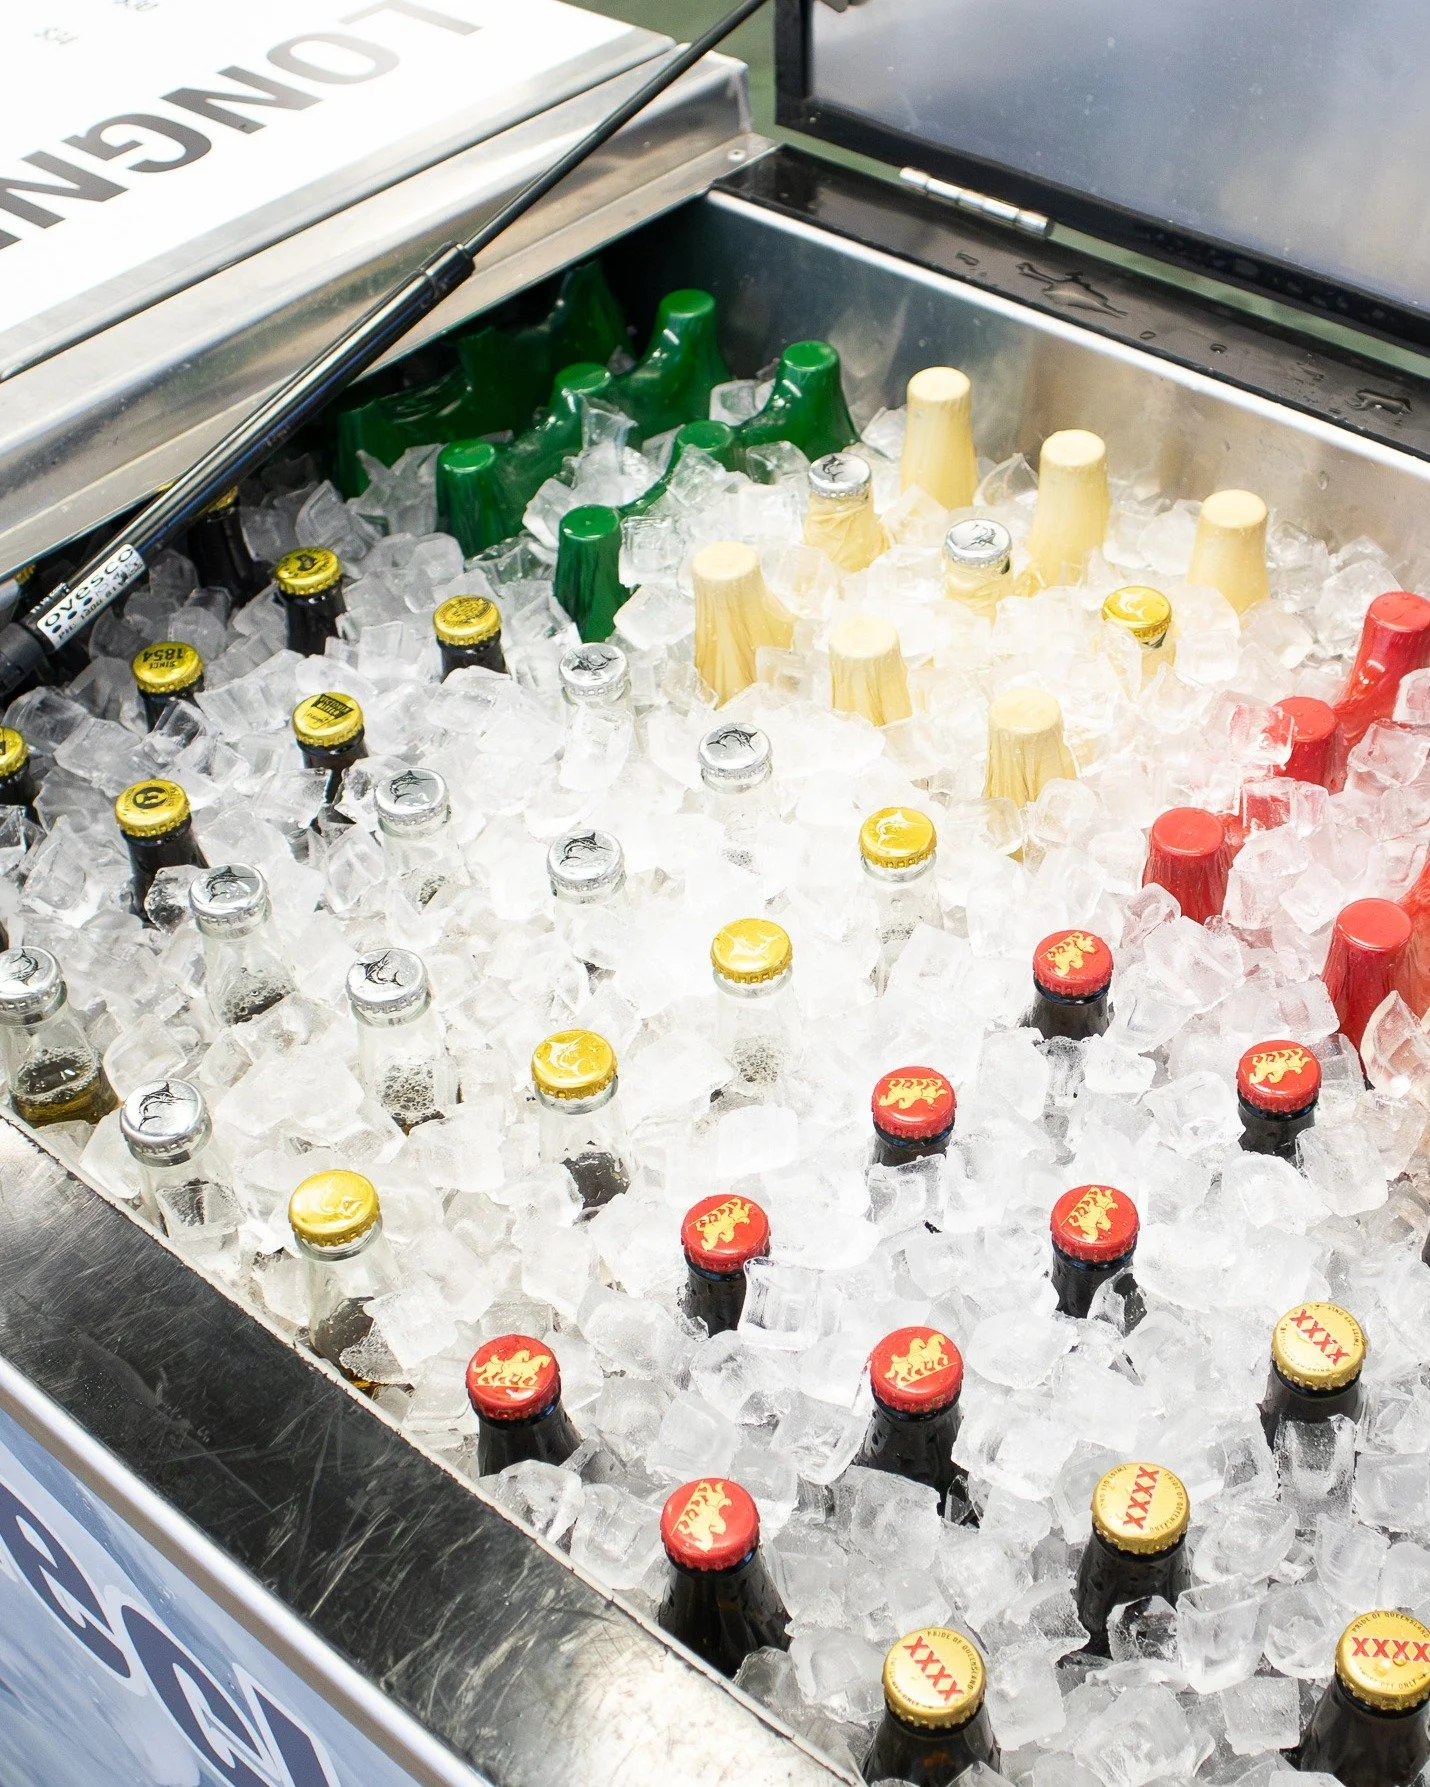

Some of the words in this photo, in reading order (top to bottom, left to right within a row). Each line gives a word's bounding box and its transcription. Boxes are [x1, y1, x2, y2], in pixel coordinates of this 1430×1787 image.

[0, 0, 484, 249] LONGN
[44, 547, 134, 628] ovesco
[143, 648, 184, 663] 1854
[1327, 1305, 1344, 1316] ONLY
[1344, 1316, 1355, 1327] OFF
[1289, 1308, 1351, 1366] XXXX
[1352, 1327, 1360, 1347] TWIST
[1123, 1465, 1160, 1530] XXXX
[1351, 1616, 1371, 1633] PRIDE
[1384, 1612, 1430, 1639] QUEENSLAND
[926, 1630, 952, 1640] PRIDE
[952, 1636, 963, 1645] OF
[961, 1645, 980, 1690] QUEENSLAND
[1351, 1636, 1430, 1663] XXXX
[902, 1635, 965, 1703] XXXX
[1398, 1678, 1418, 1691] ONLY
